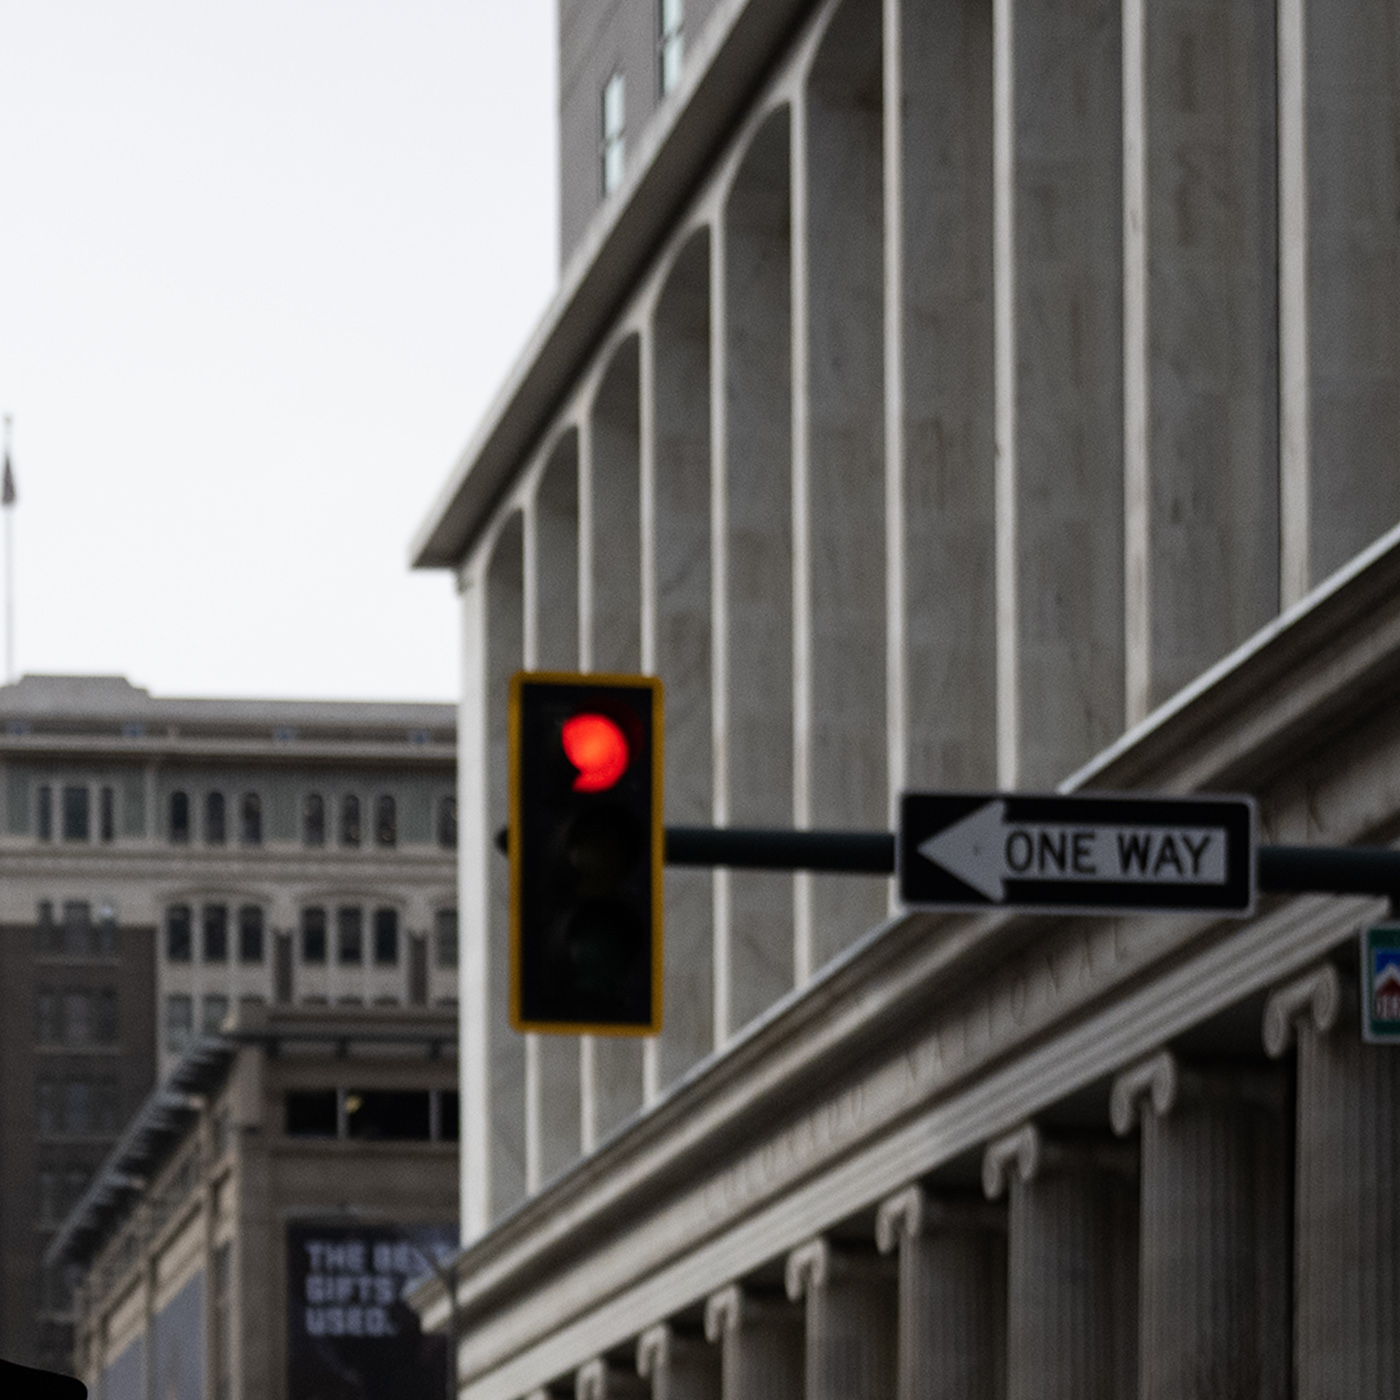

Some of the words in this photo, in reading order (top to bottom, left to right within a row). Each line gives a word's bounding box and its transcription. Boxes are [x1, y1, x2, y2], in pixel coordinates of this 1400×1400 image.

[1004, 829, 1097, 875] ONE
[1117, 830, 1213, 877] WAY
[304, 1240, 366, 1274] THE
[304, 1274, 394, 1305] GIFTS
